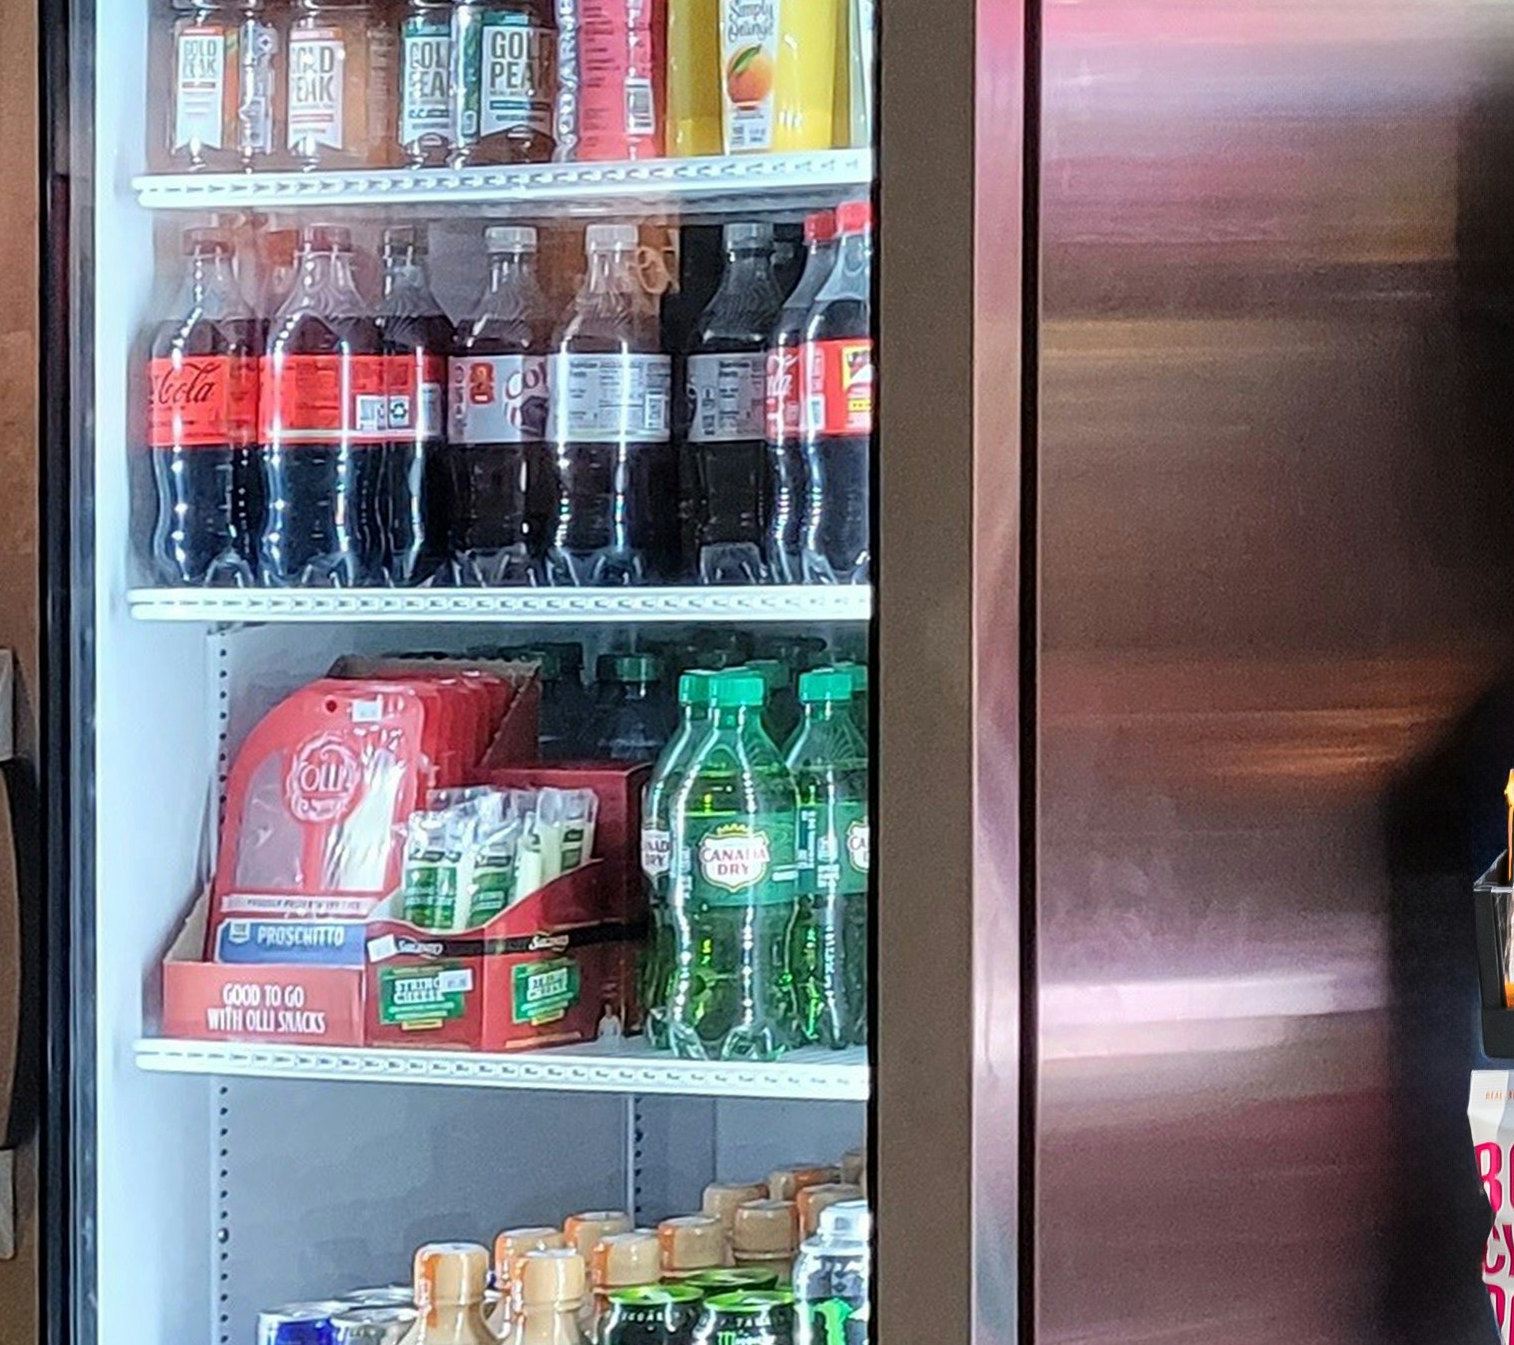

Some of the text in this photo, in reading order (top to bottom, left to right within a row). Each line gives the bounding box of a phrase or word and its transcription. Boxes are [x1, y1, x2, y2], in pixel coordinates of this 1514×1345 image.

[701, 844, 767, 867] CANADA
[717, 861, 750, 877] DRY
[223, 984, 303, 1005] GOOD TO GO
[207, 1009, 242, 1031] WITH
[276, 1011, 325, 1034] SNACKS
